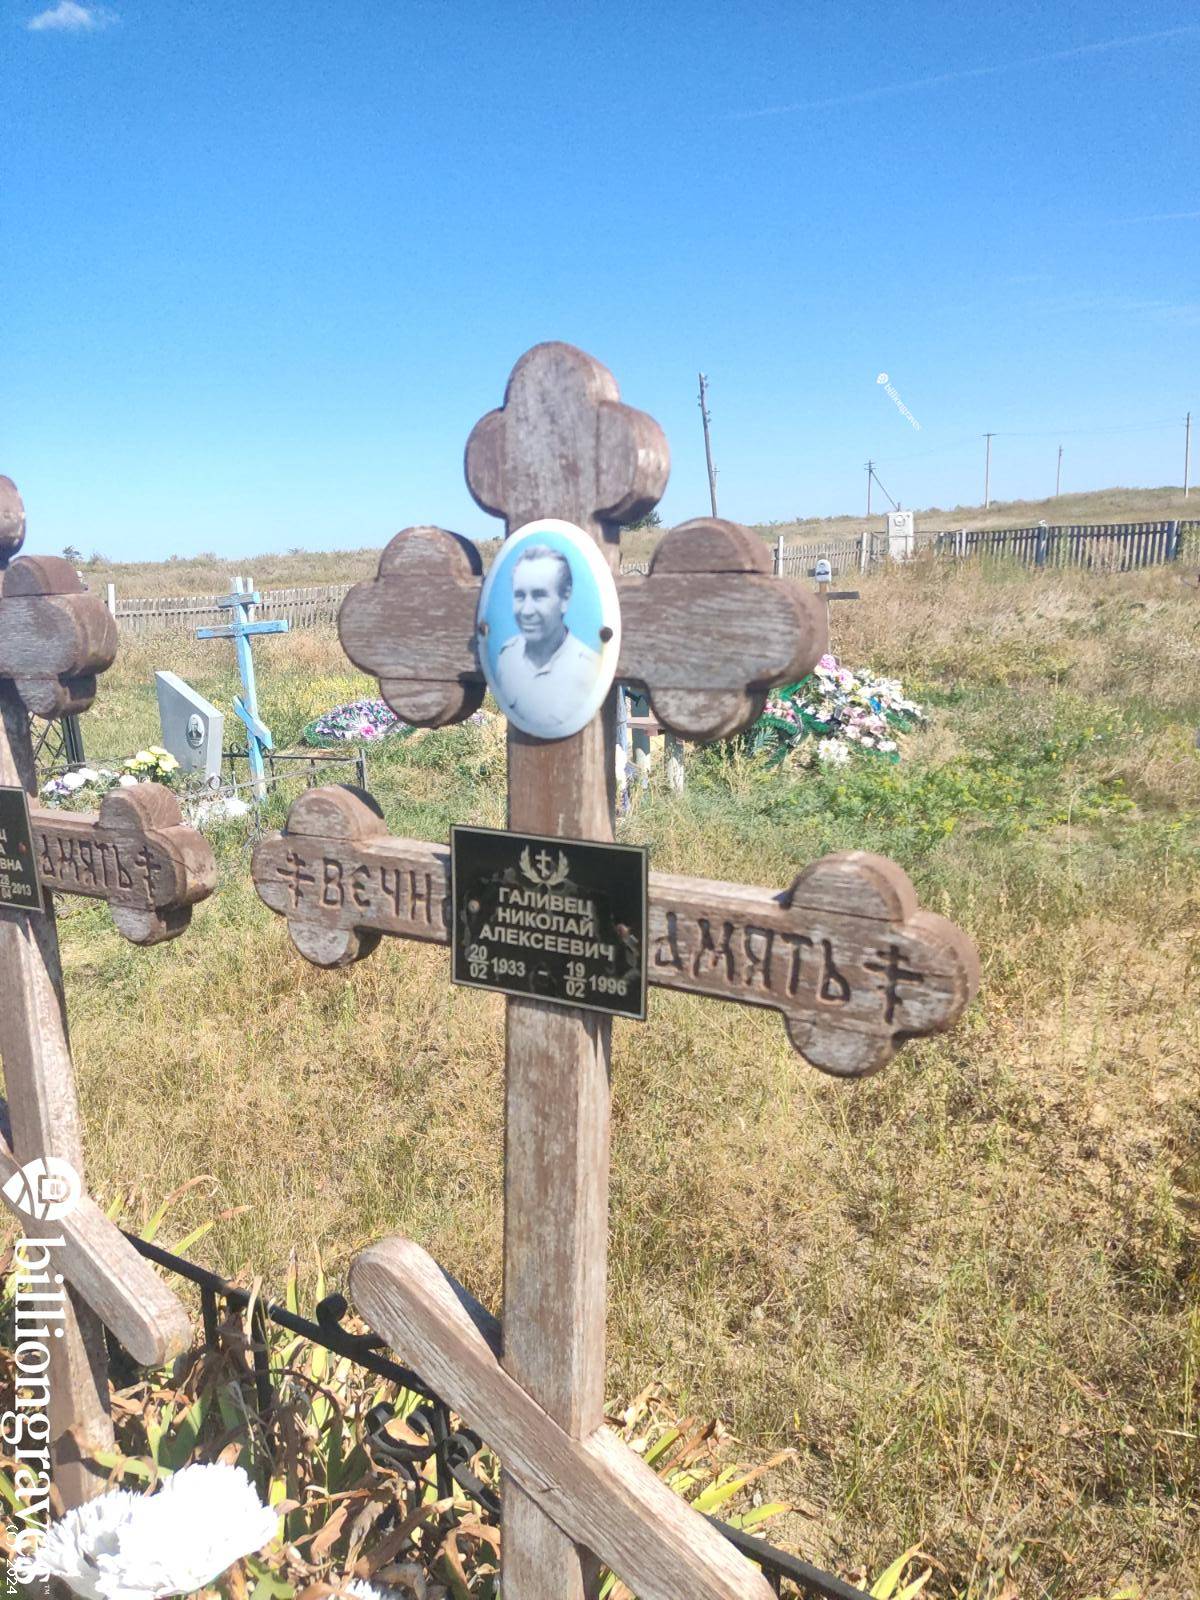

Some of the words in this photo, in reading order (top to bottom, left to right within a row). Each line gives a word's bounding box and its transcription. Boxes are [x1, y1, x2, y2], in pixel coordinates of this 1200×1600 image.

[0, 858, 24, 872] ВНА
[41, 834, 133, 889] АМЯТЬ
[11, 882, 32, 897] 2013
[322, 857, 432, 924] ВЕЧН
[498, 886, 593, 920] ГАЛИВЕЦ
[497, 906, 594, 938] НИКОЛАЙ
[469, 944, 488, 960] 20
[479, 924, 615, 962] АЛЕКСЕЕВИЧ
[491, 957, 526, 977] 1933
[655, 911, 850, 1004] АМЯТЬ
[469, 963, 488, 980] 02
[566, 961, 586, 977] 19
[565, 981, 585, 998] 02
[589, 975, 627, 997] 1996
